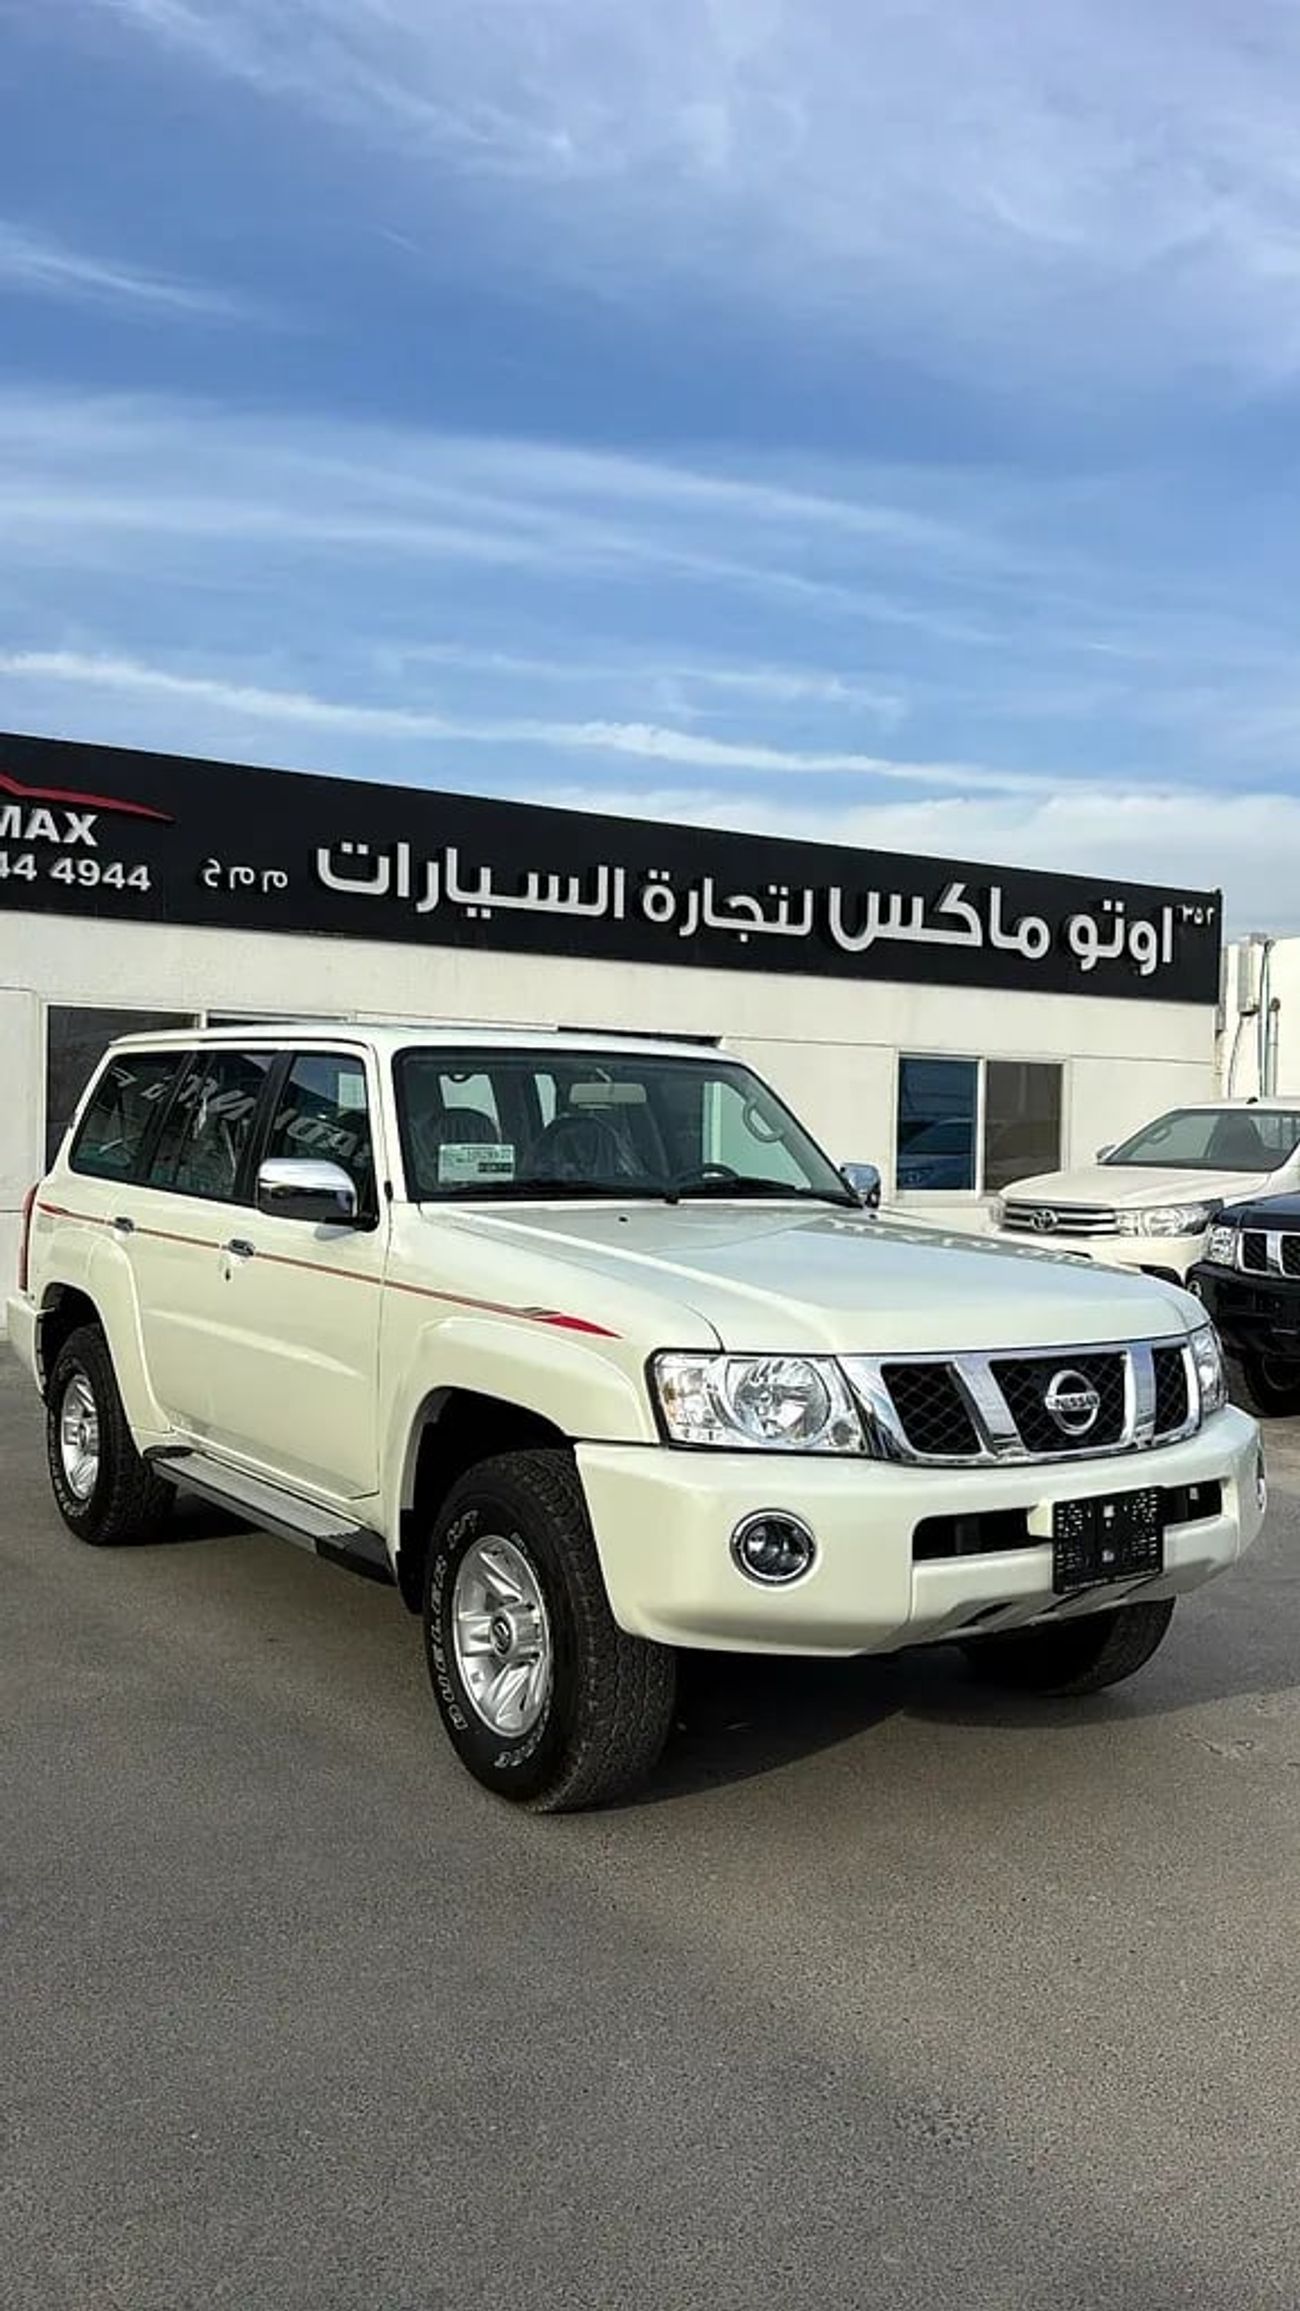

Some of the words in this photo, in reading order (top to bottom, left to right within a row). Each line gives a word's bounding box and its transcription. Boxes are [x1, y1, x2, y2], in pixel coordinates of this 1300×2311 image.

[50, 857, 151, 891] 4944
[317, 842, 625, 919] السيارات
[642, 869, 813, 943] لتجارة
[829, 882, 1051, 959] ماكس
[1069, 899, 1173, 976] اوتو
[1046, 1391, 1099, 1410] NISSAN
